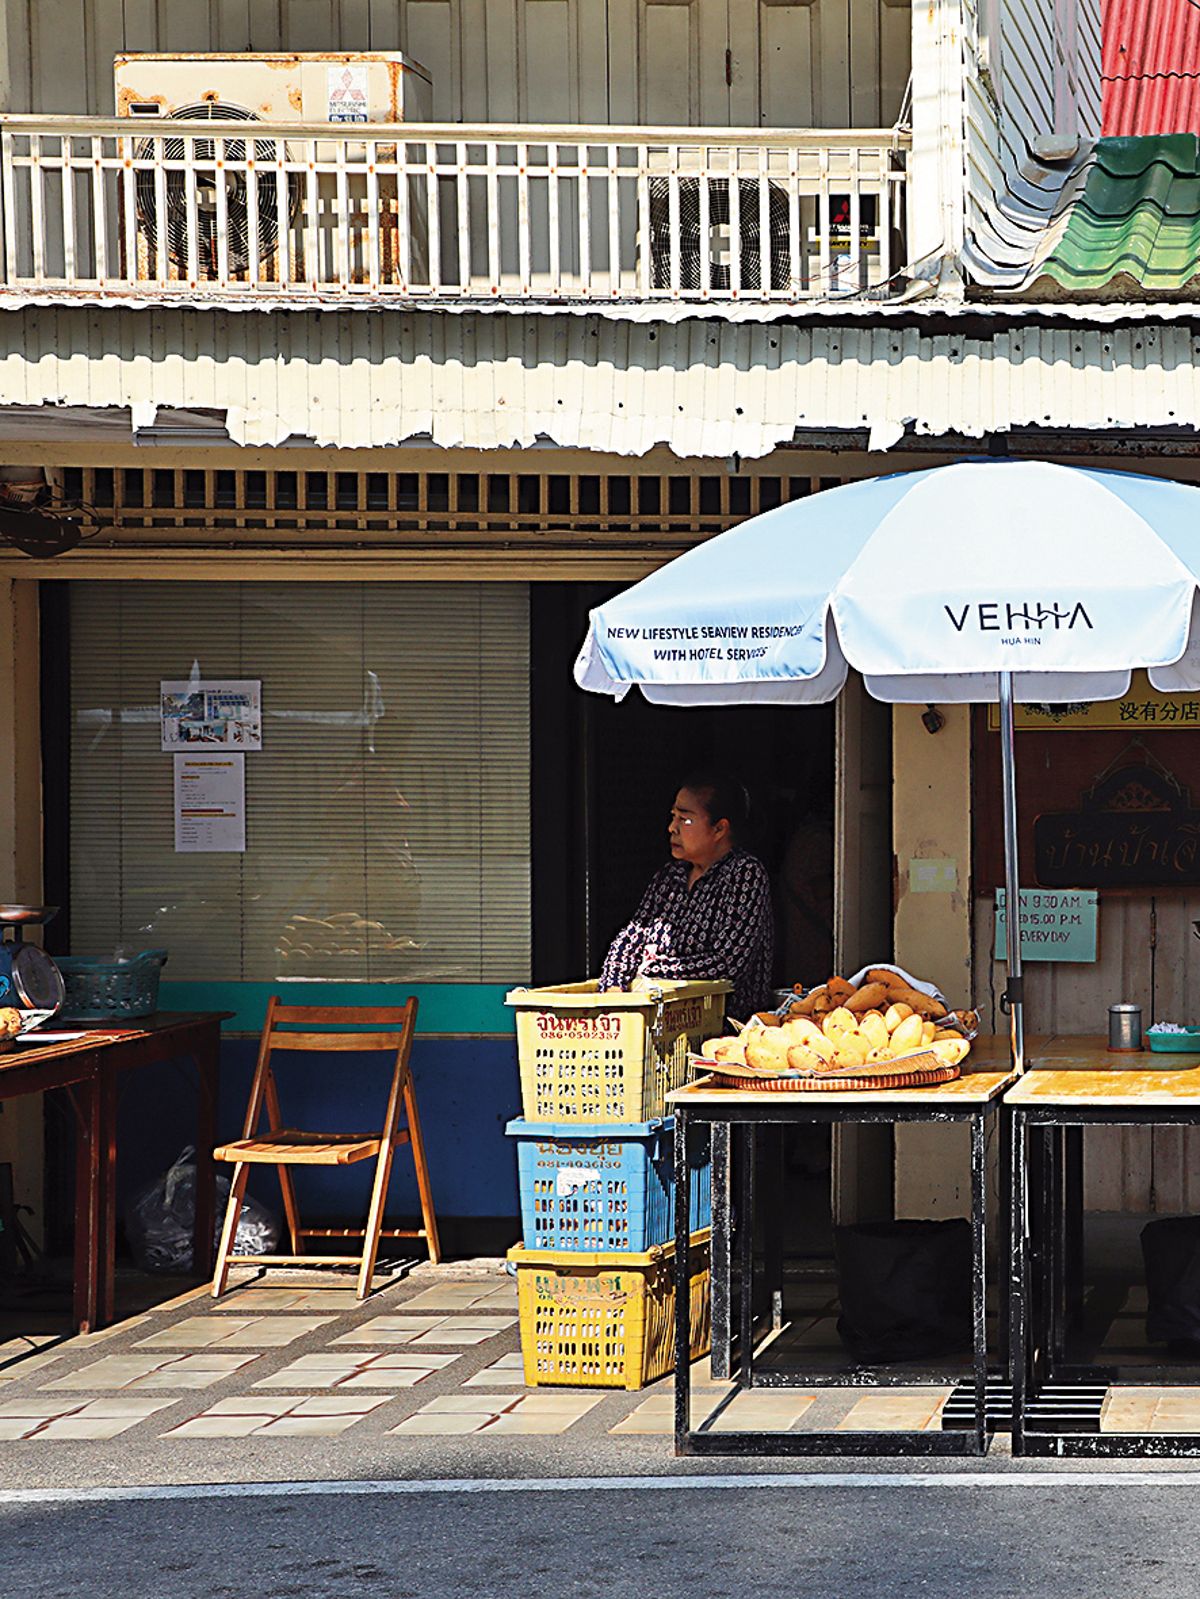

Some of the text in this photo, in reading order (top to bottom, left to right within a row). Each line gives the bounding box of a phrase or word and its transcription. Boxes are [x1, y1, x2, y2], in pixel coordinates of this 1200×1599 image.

[607, 627, 640, 640] NEW
[642, 627, 699, 640] LIFESTYLE
[701, 626, 749, 639] SEAVIEW
[1001, 637, 1042, 646] HUA HIN
[653, 649, 687, 661] WITH
[689, 647, 724, 661] HOTEL
[1119, 701, 1200, 721] 没有分店
[999, 894, 1029, 909] ON
